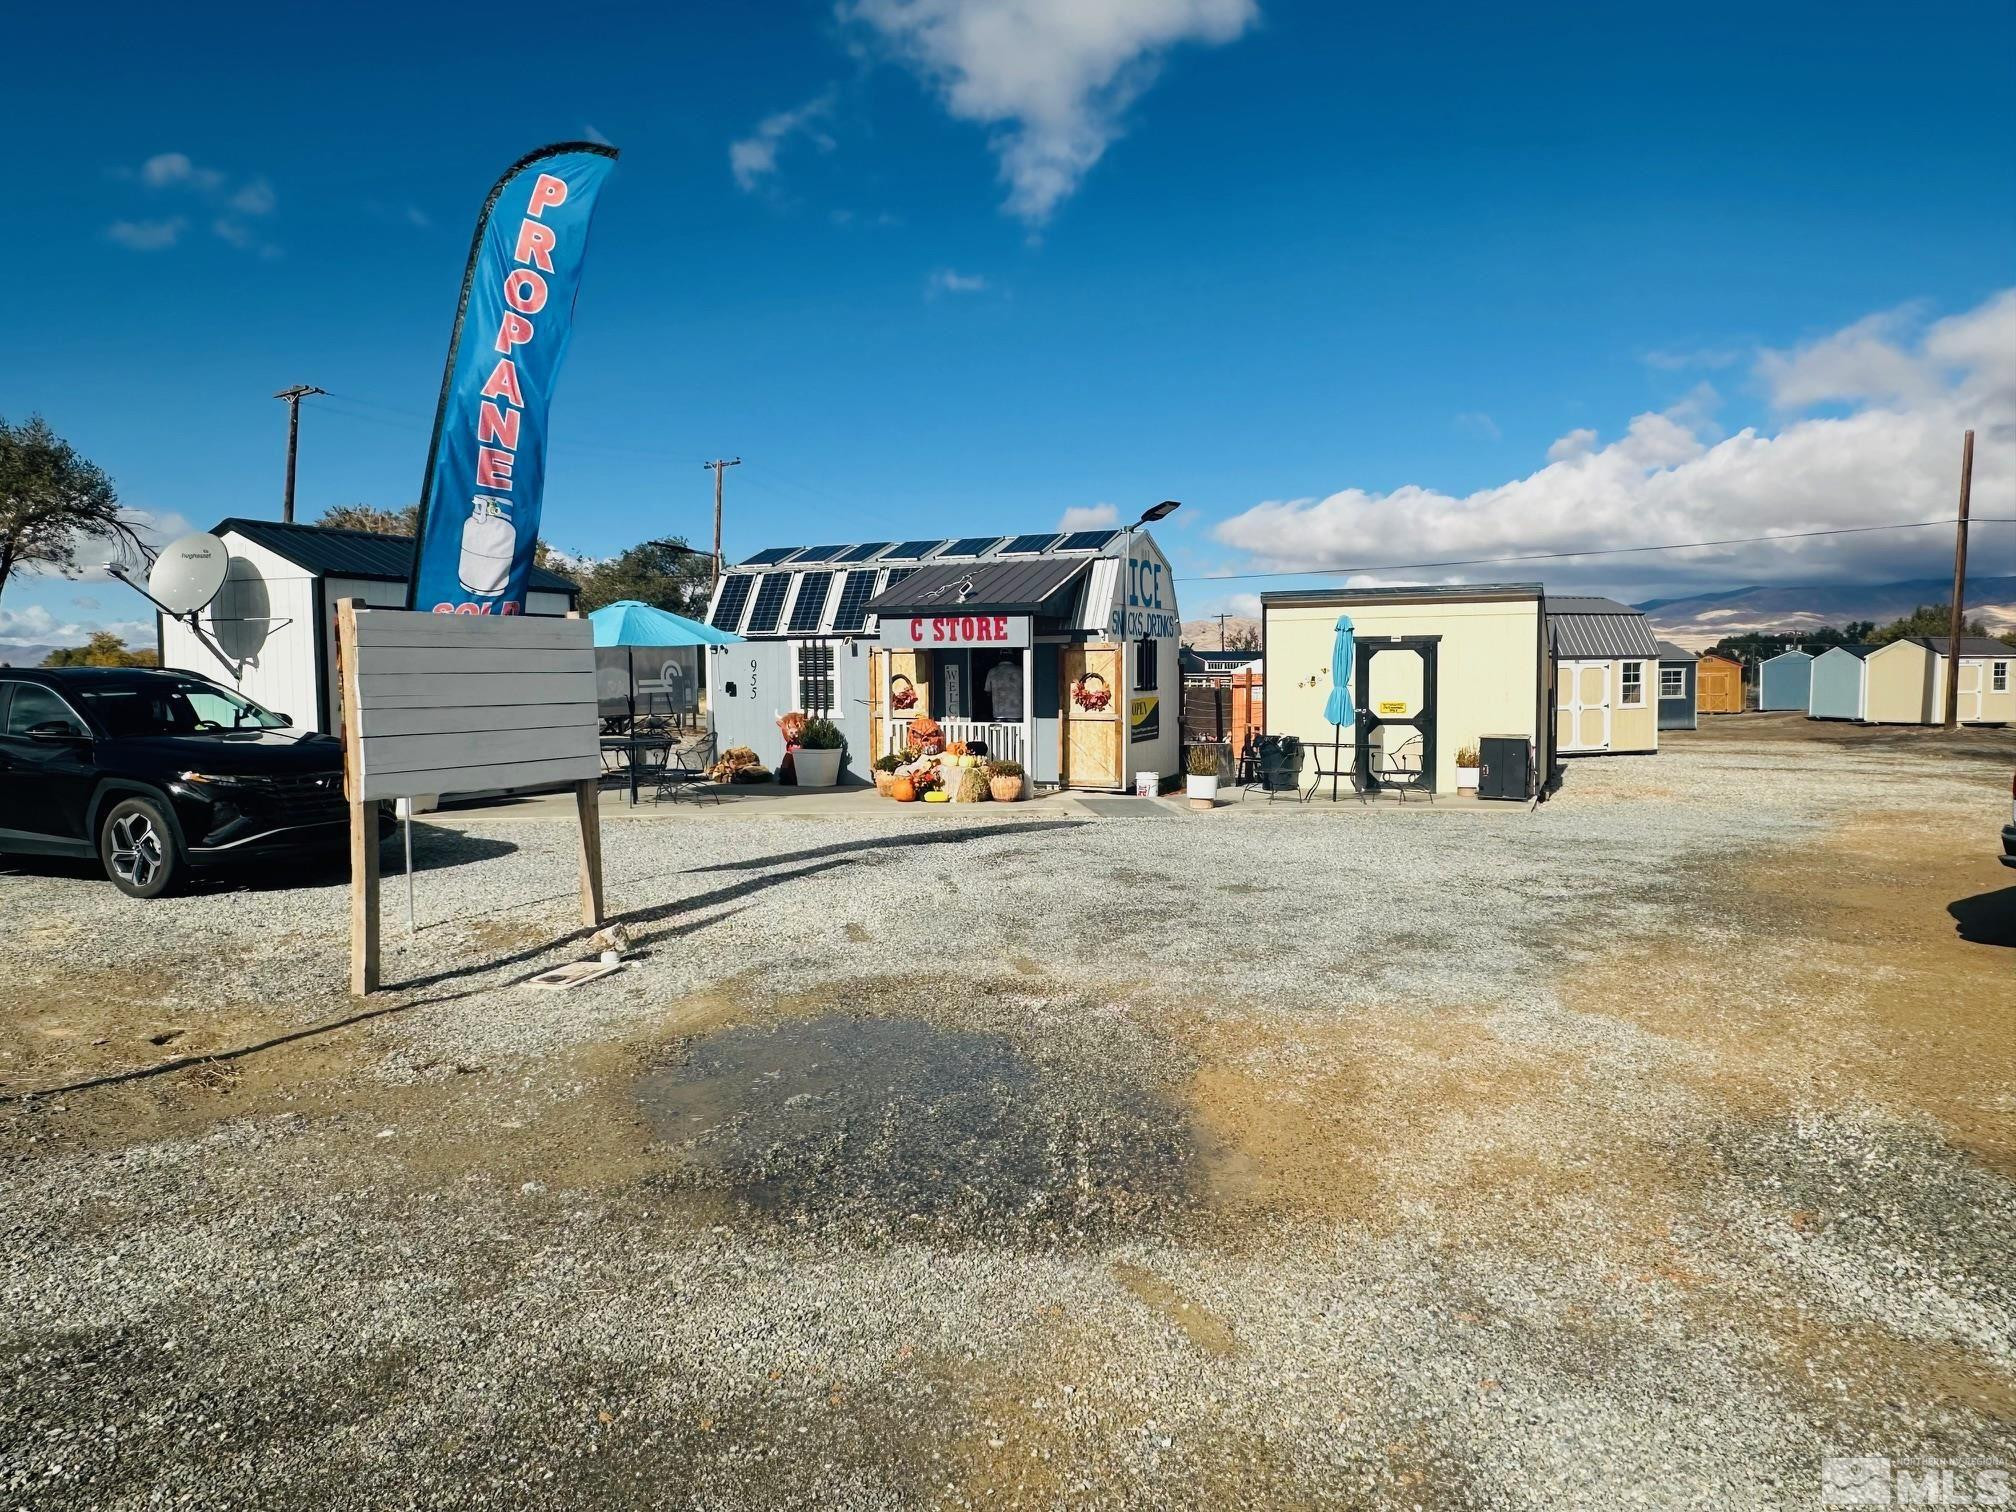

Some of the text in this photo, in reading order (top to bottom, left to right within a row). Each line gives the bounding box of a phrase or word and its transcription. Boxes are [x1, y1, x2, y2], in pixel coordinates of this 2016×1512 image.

[477, 173, 568, 490] PROPANE
[1128, 559, 1162, 609] ICE
[910, 616, 1008, 641] C STORE
[1112, 610, 1174, 638] SNCKS DRINKS
[946, 670, 959, 715] WELC
[1131, 701, 1148, 715] OPEN
